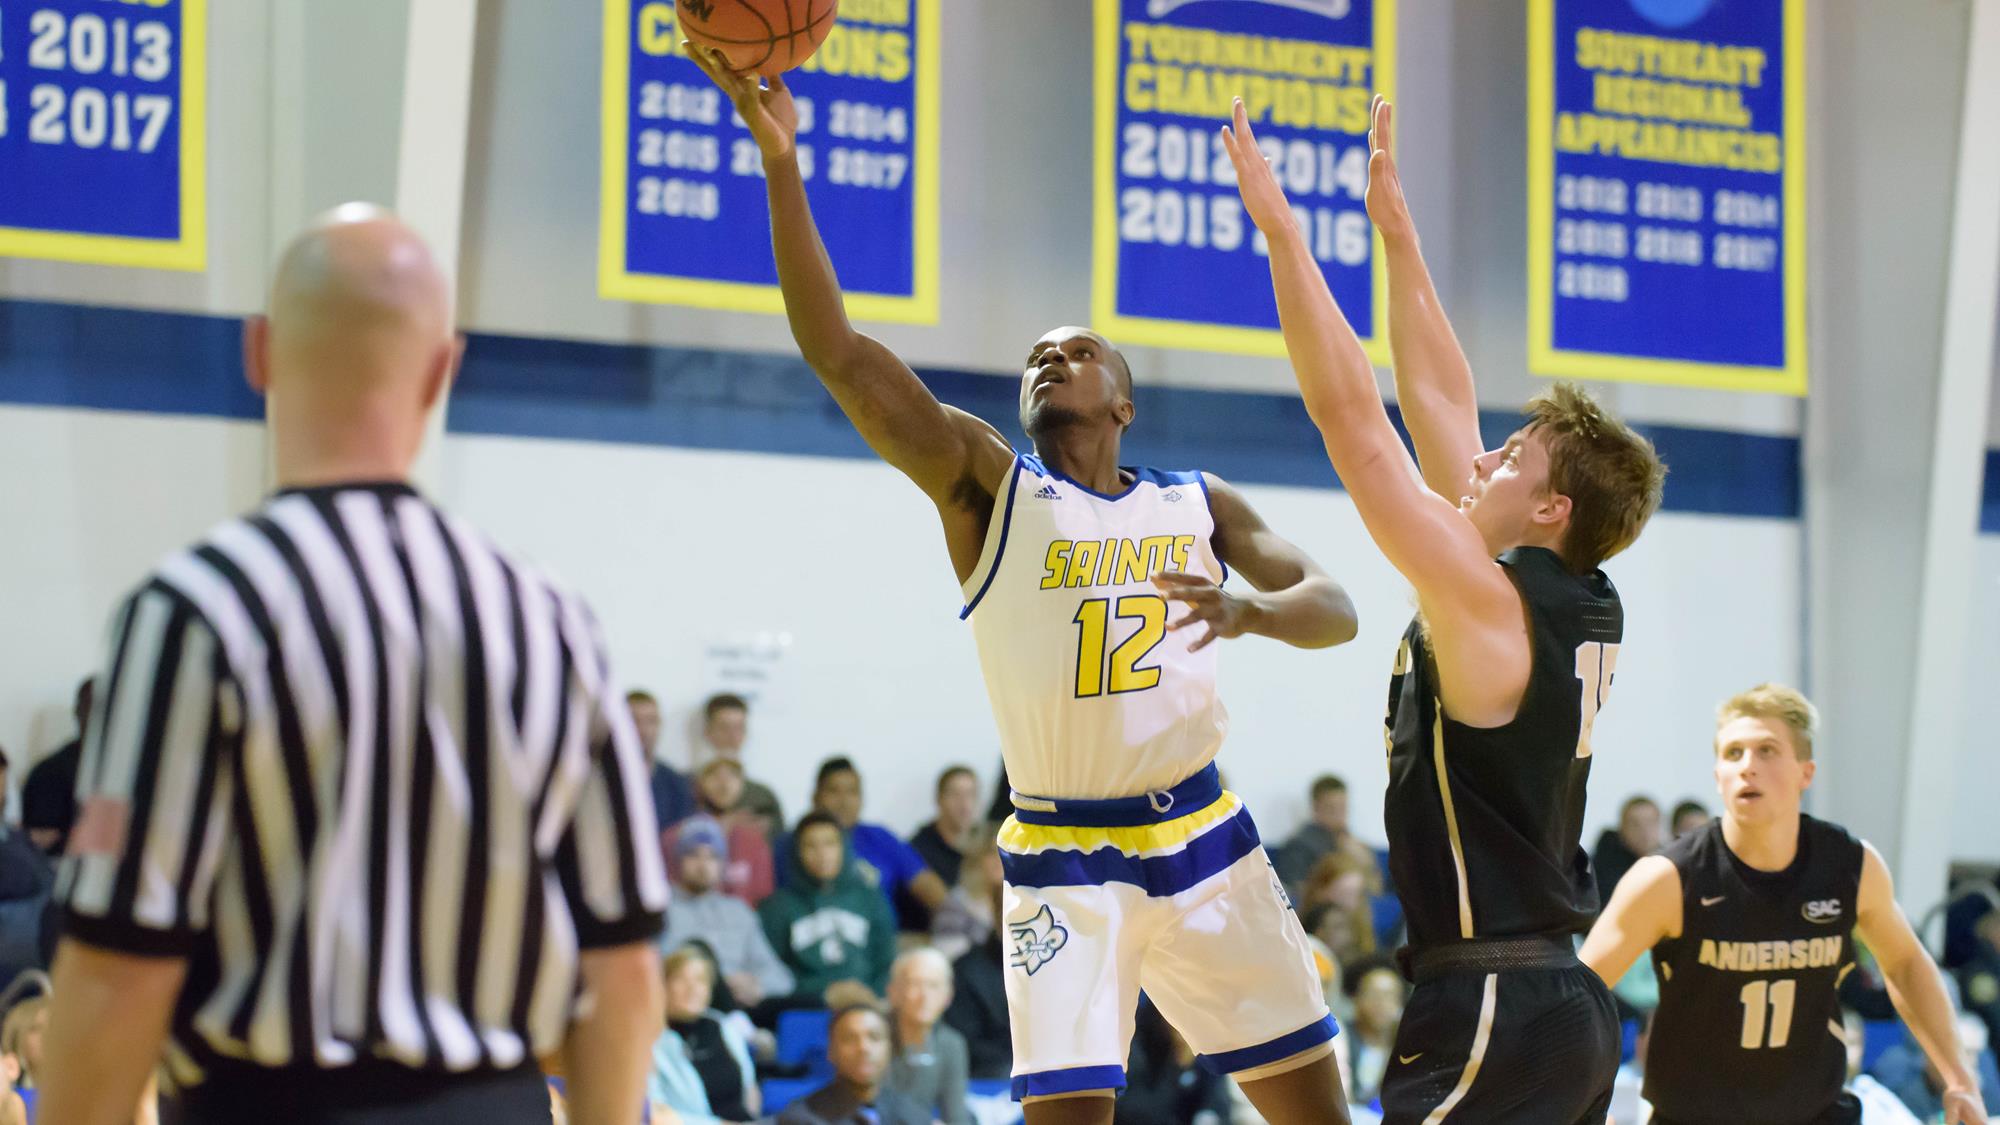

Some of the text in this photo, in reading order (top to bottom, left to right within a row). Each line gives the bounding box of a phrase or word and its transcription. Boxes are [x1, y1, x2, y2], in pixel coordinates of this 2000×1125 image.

[28, 9, 172, 82] 2013
[1124, 22, 1370, 81] TOURNAMENT
[1575, 26, 1766, 88] SOUTHEAST
[28, 83, 172, 153] 2017
[828, 100, 907, 144] 2014
[1124, 63, 1369, 135] CHAMPIONS
[1593, 72, 1751, 127] REGIONAL
[828, 147, 907, 190] 2017
[1121, 121, 1237, 188] 2012
[1556, 111, 1781, 173] APPEARANCES
[1121, 187, 1369, 267] 2015 16
[1034, 492, 1062, 501] adidas
[1040, 535, 1195, 590] SAINTS
[1072, 594, 1168, 698] 12
[1807, 899, 1842, 918] SAC
[1698, 935, 1842, 973] ANDERSON
[1740, 979, 1796, 1049] 11
